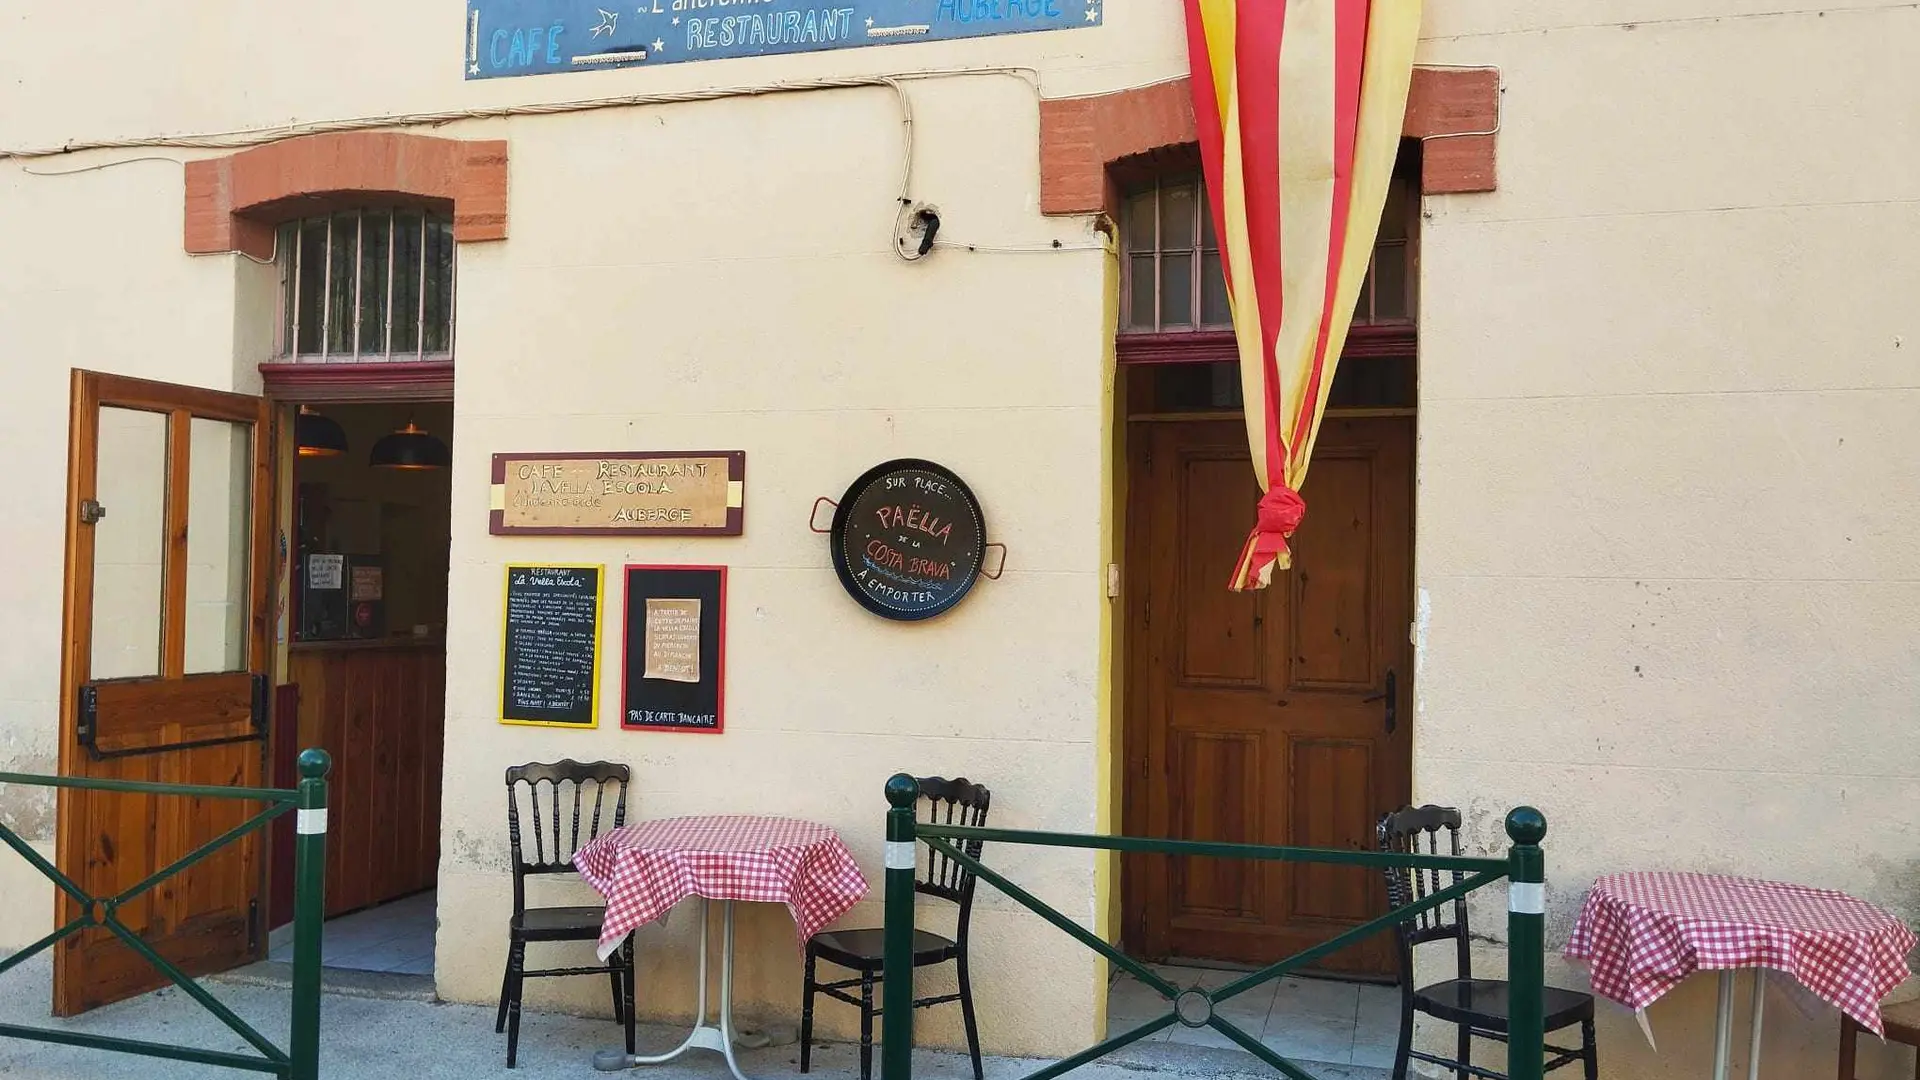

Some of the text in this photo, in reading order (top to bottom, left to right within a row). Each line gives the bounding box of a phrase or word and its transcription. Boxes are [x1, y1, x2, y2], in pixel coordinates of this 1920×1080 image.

[687, 8, 855, 50] RESTAURANT
[490, 19, 565, 68] CAFÉ
[518, 462, 708, 480] CAFE RESTAURANT
[602, 480, 673, 495] ESCOLA
[886, 477, 906, 490] SUR
[612, 507, 693, 523] AUBERGE
[876, 503, 952, 546] PAËLLA
[866, 539, 950, 580] COSTA BRAVA
[531, 568, 571, 576] RESTAURANT
[530, 576, 555, 586] Vella
[868, 579, 935, 602] EMPORTER
[629, 710, 715, 725] PAS DE CARTE BANCAIRE
